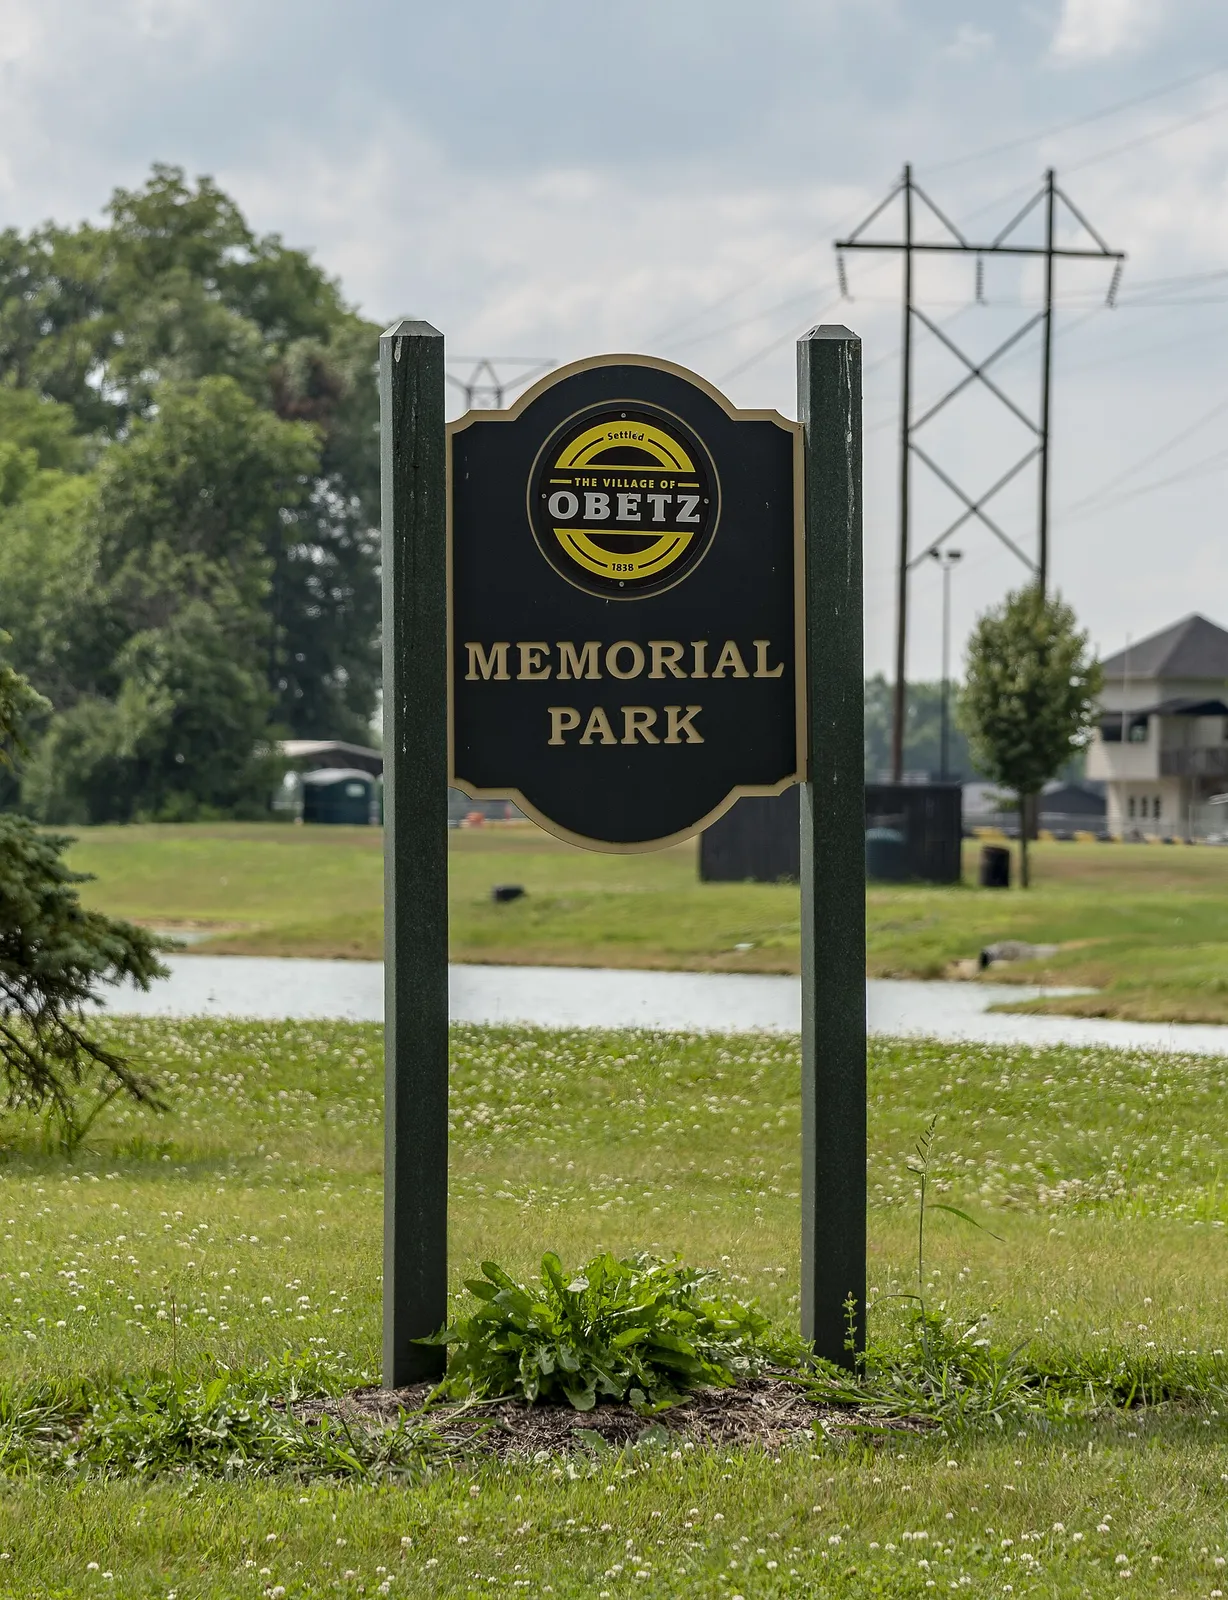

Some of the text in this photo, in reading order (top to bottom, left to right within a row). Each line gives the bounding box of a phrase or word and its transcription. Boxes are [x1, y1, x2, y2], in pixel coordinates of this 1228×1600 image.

[607, 430, 645, 441] Settled
[574, 477, 676, 489] THE VILLAGE OF
[548, 490, 701, 523] OBETZ
[612, 563, 634, 572] 1838
[464, 640, 785, 680] MEMORIAL
[547, 705, 705, 745] PARK
